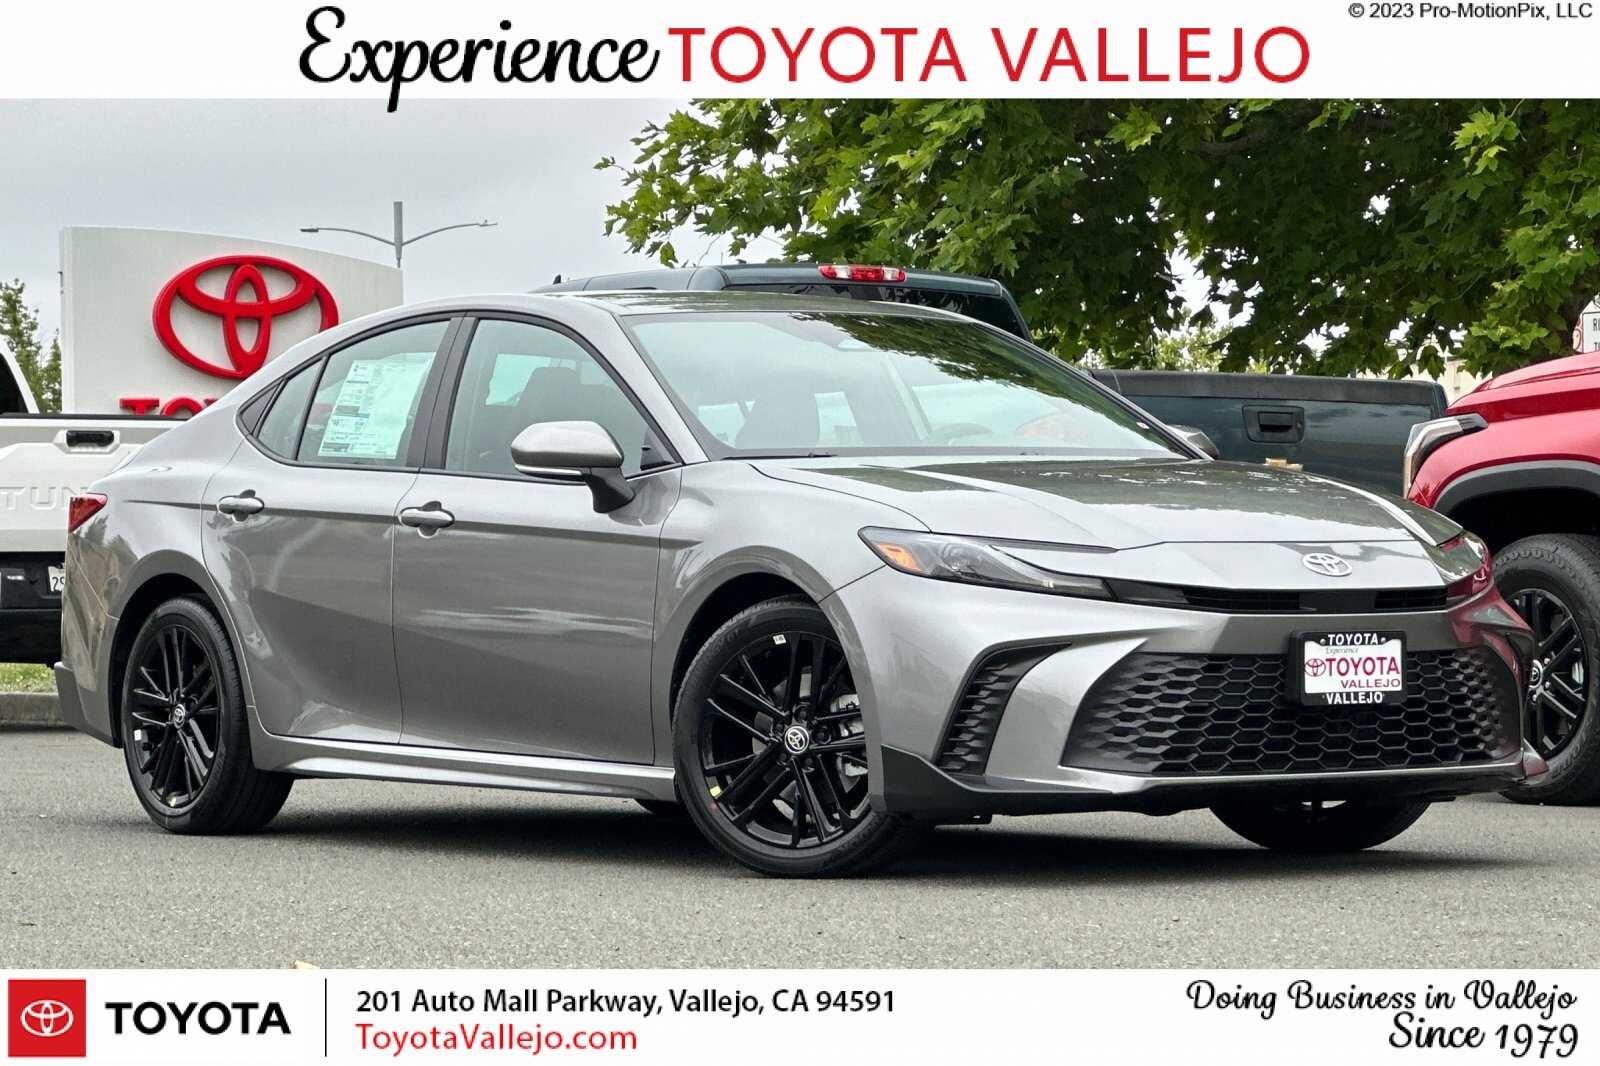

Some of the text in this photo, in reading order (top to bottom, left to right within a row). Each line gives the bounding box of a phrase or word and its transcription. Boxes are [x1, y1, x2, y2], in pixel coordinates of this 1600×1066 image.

[118, 397, 219, 417] TO
[1328, 633, 1379, 646] TOYOTA
[1325, 656, 1401, 677] TOYOTA
[1340, 678, 1401, 689] VALLEJO
[1326, 691, 1383, 705] VALLEJO
